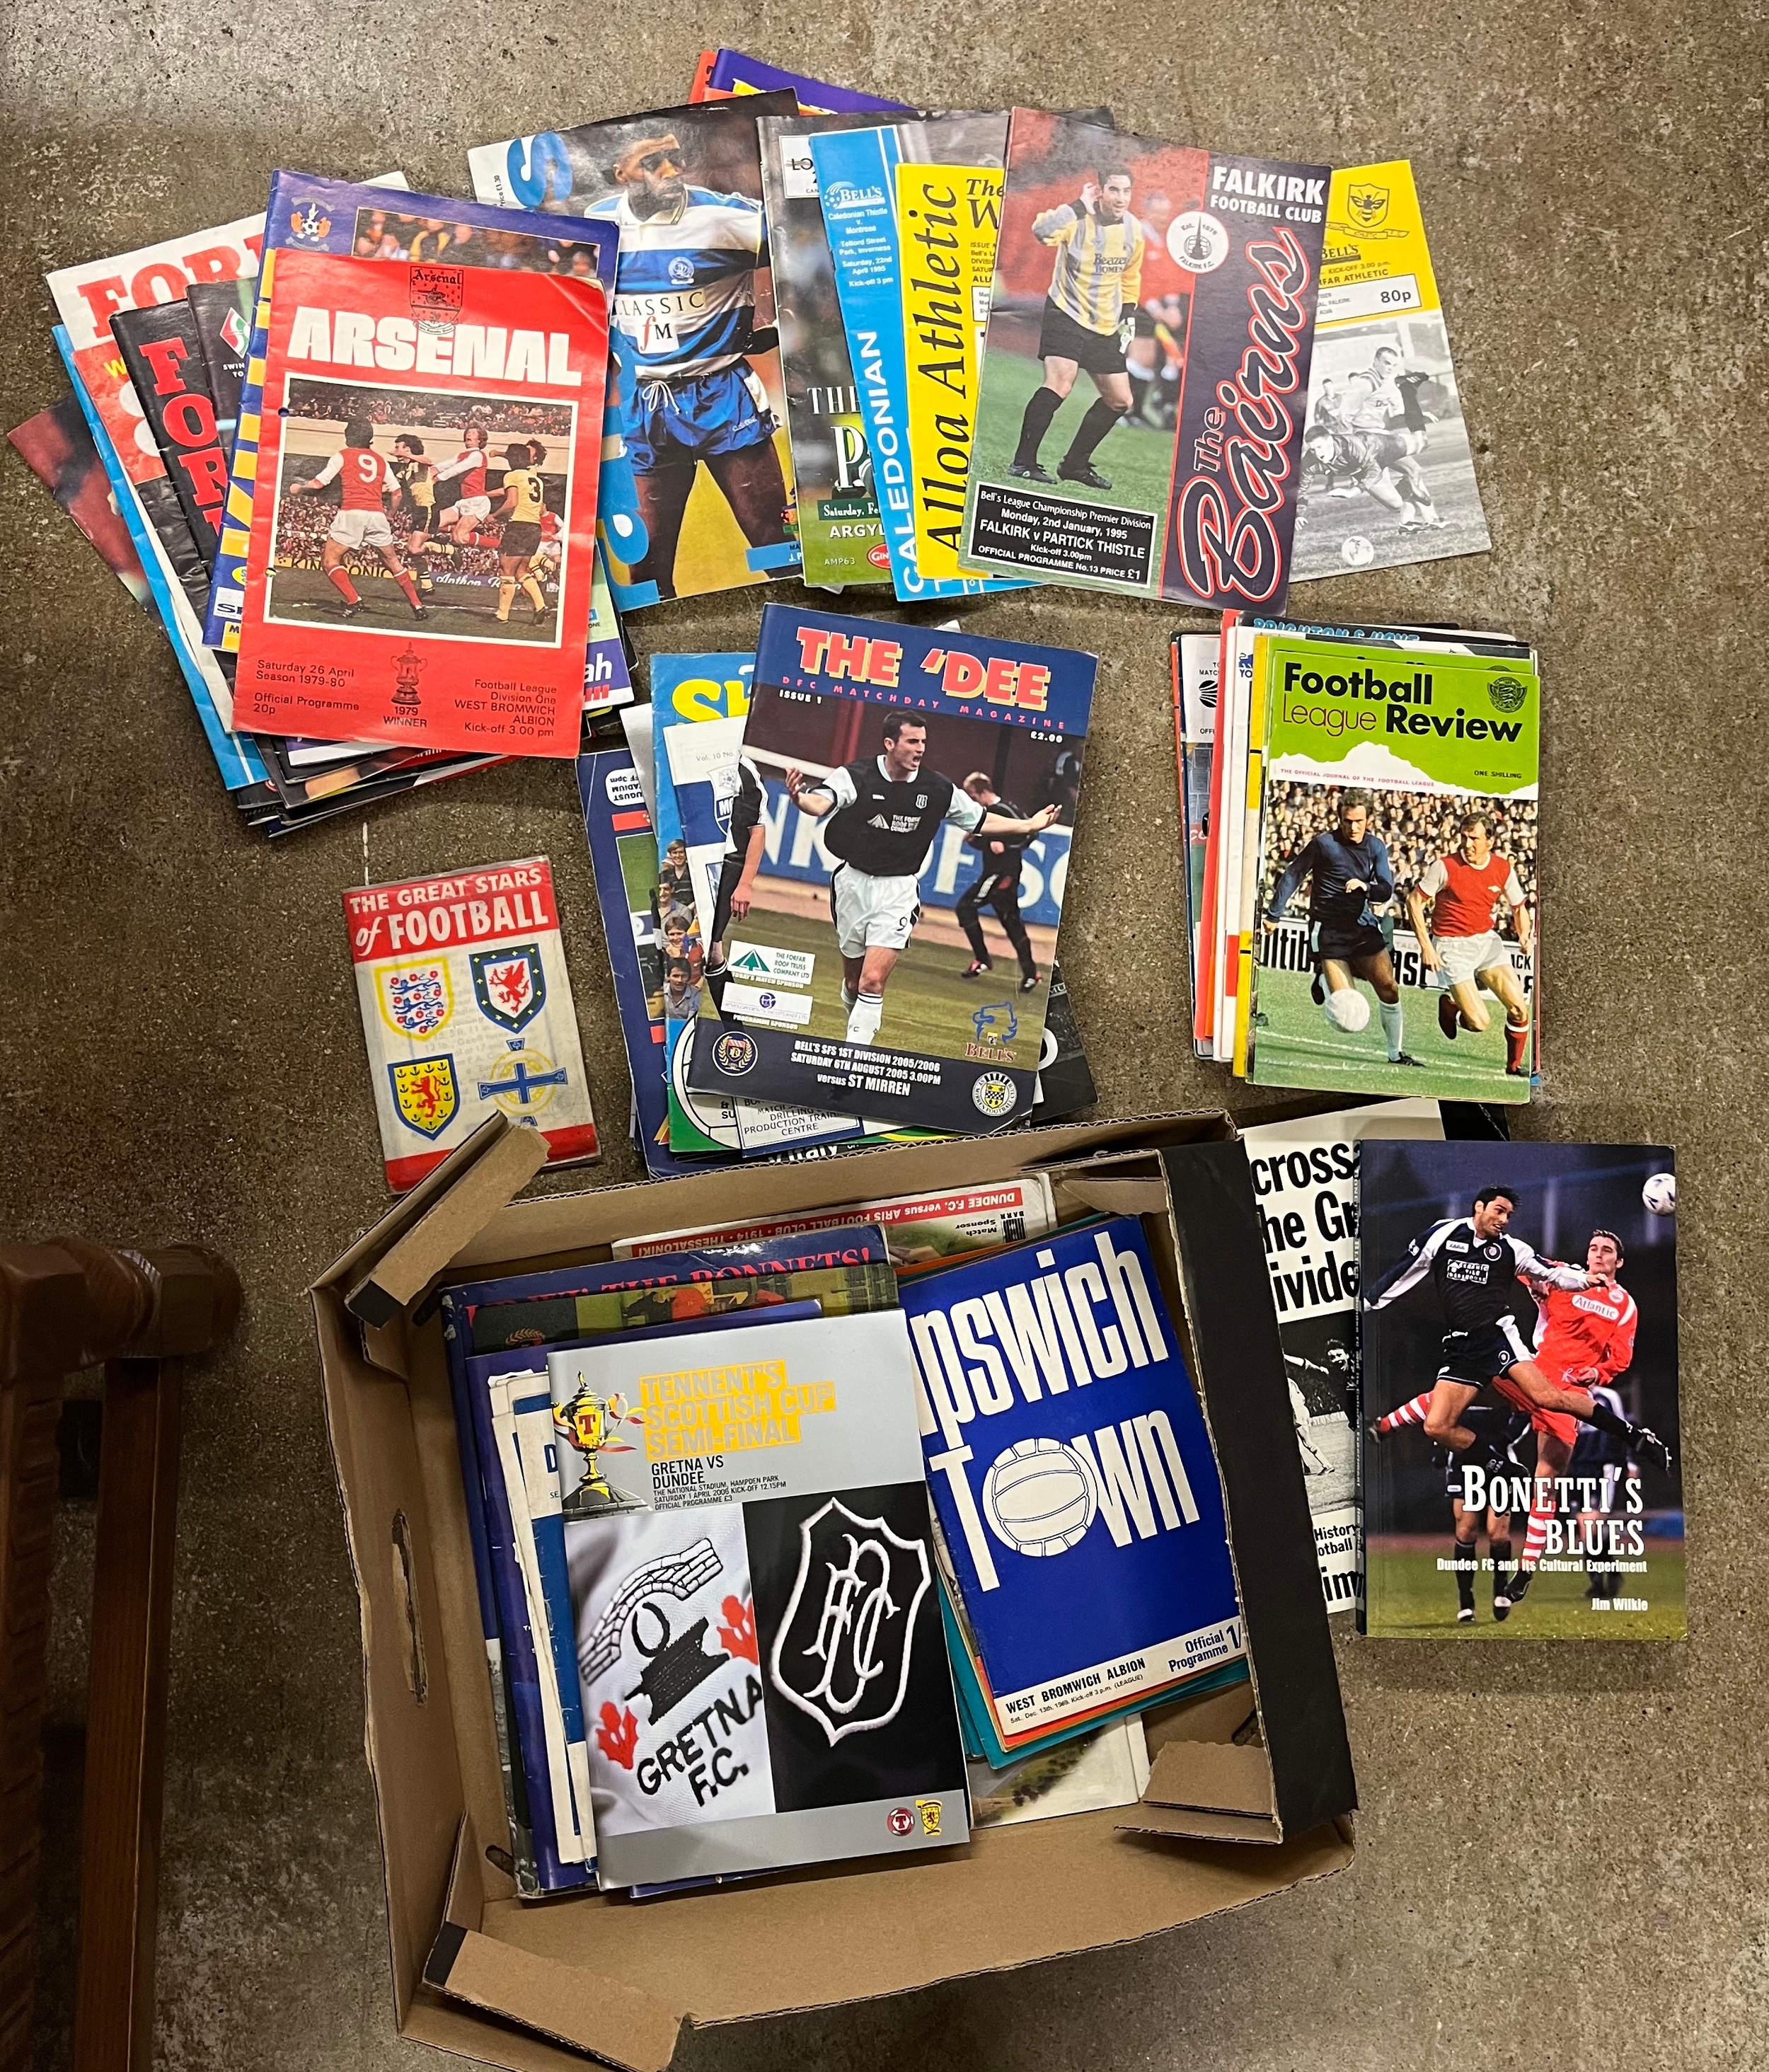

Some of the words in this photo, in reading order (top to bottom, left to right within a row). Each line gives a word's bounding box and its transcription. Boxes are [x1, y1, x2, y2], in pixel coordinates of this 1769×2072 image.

[840, 185, 884, 202] BELL'S
[1211, 166, 1326, 206] FALKIRK
[828, 209, 865, 221] Caledonian
[865, 207, 888, 217] Thistle
[1210, 194, 1281, 219] FOOTBALL
[1284, 206, 1322, 224] CLUB
[846, 225, 876, 234] Montrose
[412, 267, 461, 284] Arsenal
[852, 267, 868, 275] April
[1095, 265, 1124, 274] HOMES
[909, 183, 966, 399] Athletic
[1380, 289, 1412, 304] 80p
[287, 306, 582, 387] ARSENAL
[1178, 226, 1311, 604] Bairns
[1193, 407, 1226, 472] The
[358, 454, 377, 483] 9
[856, 330, 924, 594] CALEDONIAN
[527, 477, 541, 503] 3
[921, 414, 969, 553] Alloa
[980, 490, 1001, 503] Bell's
[1003, 495, 1032, 510] League
[1032, 500, 1088, 521] Championship
[1089, 510, 1119, 526] Premier
[1120, 515, 1152, 530] Division
[1001, 508, 1041, 526] Monday,
[1042, 516, 1061, 528] 2nd
[1062, 520, 1103, 538] January,
[1105, 528, 1128, 540] 1995
[979, 519, 1030, 539] FALKIRK
[1033, 531, 1041, 541] v
[1042, 532, 1094, 551] PARTICK
[1097, 540, 1146, 559] THISTLE
[824, 557, 855, 566] AMP63
[1030, 543, 1061, 556] Kick-off
[1063, 549, 1093, 562] 3.00pm
[978, 545, 1017, 559] OFFICIAL
[1018, 552, 1073, 570] PROGRAMME
[1075, 562, 1098, 573] No.13
[1100, 566, 1126, 578] PRICE
[1127, 569, 1141, 580] £1
[256, 669, 295, 683] Season
[299, 674, 345, 688] 1979-80
[257, 660, 306, 674] Saturday
[309, 664, 325, 674] 26
[328, 666, 355, 678] April
[796, 626, 904, 689] THE
[919, 648, 1051, 713] 'DEE
[475, 679, 517, 691] Football
[519, 681, 557, 695] League
[1284, 662, 1433, 706] Football
[254, 691, 293, 705] Official
[297, 696, 359, 712] Programme
[490, 691, 532, 703] Division
[535, 693, 556, 704] One
[778, 689, 813, 703] ISSUE
[816, 695, 823, 705] 1
[782, 676, 817, 690] DFC
[833, 684, 940, 709] MATCHDAY
[959, 705, 1066, 730] MAGAZINE
[253, 703, 276, 715] 20p
[393, 706, 419, 716] 1979
[454, 698, 487, 711] WEST
[490, 701, 555, 716] BROMWICH
[383, 715, 427, 728] WINNER
[512, 715, 555, 727] ALBION
[1283, 693, 1377, 737] League
[1385, 703, 1523, 743] Review
[463, 720, 506, 734] Kick-off
[507, 724, 534, 735] 3.00
[537, 728, 555, 738] pm
[1030, 730, 1064, 744] £2.00
[1490, 771, 1522, 779] SHILLING
[350, 892, 389, 914] THE
[396, 880, 466, 909] GREAT
[475, 868, 543, 894] STARS
[355, 919, 383, 957] of
[387, 891, 549, 950] FOOTBALL
[786, 954, 806, 962] FORFAR
[773, 968, 800, 977] COMPANY
[733, 1014, 770, 1026] PROGRAMME
[771, 1020, 798, 1030] SPONSOR
[794, 1039, 821, 1054] BELL'S
[821, 1044, 836, 1056] SFS
[839, 1047, 853, 1059] 1ST
[853, 1049, 892, 1065] DIVISION
[892, 1055, 941, 1073] 2005/2006
[964, 1042, 1015, 1063] BELL'S
[790, 1052, 834, 1069] SATURDAY
[834, 1059, 851, 1071] 6TH
[851, 1062, 885, 1077] AUGUST
[885, 1067, 909, 1081] 2005
[909, 1071, 942, 1086] 3.00PM
[817, 1073, 846, 1087] versus
[847, 1074, 864, 1089] ST
[865, 1078, 911, 1097] MIRREN
[781, 1122, 819, 1136] CENTRE
[944, 1199, 964, 1211] F.C.
[968, 1192, 1015, 1207] DUNDEE
[873, 1209, 901, 1221] ARIS
[904, 1204, 941, 1216] versus
[775, 1221, 806, 1236] CLUB
[809, 1212, 870, 1231] FOOTBALL
[955, 1219, 996, 1230] Sponsor
[736, 1228, 764, 1241] 1914
[966, 1227, 997, 1237] Match
[638, 1235, 725, 1258] THESSALONIKI
[1574, 1296, 1616, 1318] Atlantic
[642, 1362, 781, 1403] TENNENT'S
[646, 1391, 771, 1430] SCOTTISH
[780, 1384, 831, 1414] CUP
[578, 1415, 597, 1435] T
[649, 1417, 796, 1457] SEMI-FINAL
[651, 1457, 703, 1475] GRETNA
[706, 1455, 724, 1469] VS
[652, 1470, 705, 1489] DUNDEE
[667, 1485, 697, 1495] NATIONAL
[698, 1482, 728, 1492] STADIUM,
[730, 1477, 761, 1487] HAMPDEN
[763, 1475, 780, 1484] PARK
[1461, 1465, 1644, 1514] BONETTI'S
[655, 1501, 681, 1511] OFFICIAL
[683, 1495, 722, 1507] PROGRAMME
[1544, 1519, 1645, 1556] BLUES
[1436, 1558, 1479, 1572] Dundee
[1482, 1559, 1495, 1572] FC
[1497, 1558, 1519, 1572] and
[1521, 1558, 1537, 1572] its
[1539, 1559, 1584, 1572] Cultural
[1586, 1559, 1648, 1574] Experiment
[1591, 1597, 1611, 1611] Jim
[1613, 1597, 1649, 1612] Wilkie
[1168, 1645, 1228, 1673] Programme
[1005, 1695, 1035, 1714] WEST
[1041, 1673, 1101, 1703] BROMWICH
[1107, 1657, 1146, 1680] ALBION
[636, 1674, 764, 1796] GRETNA
